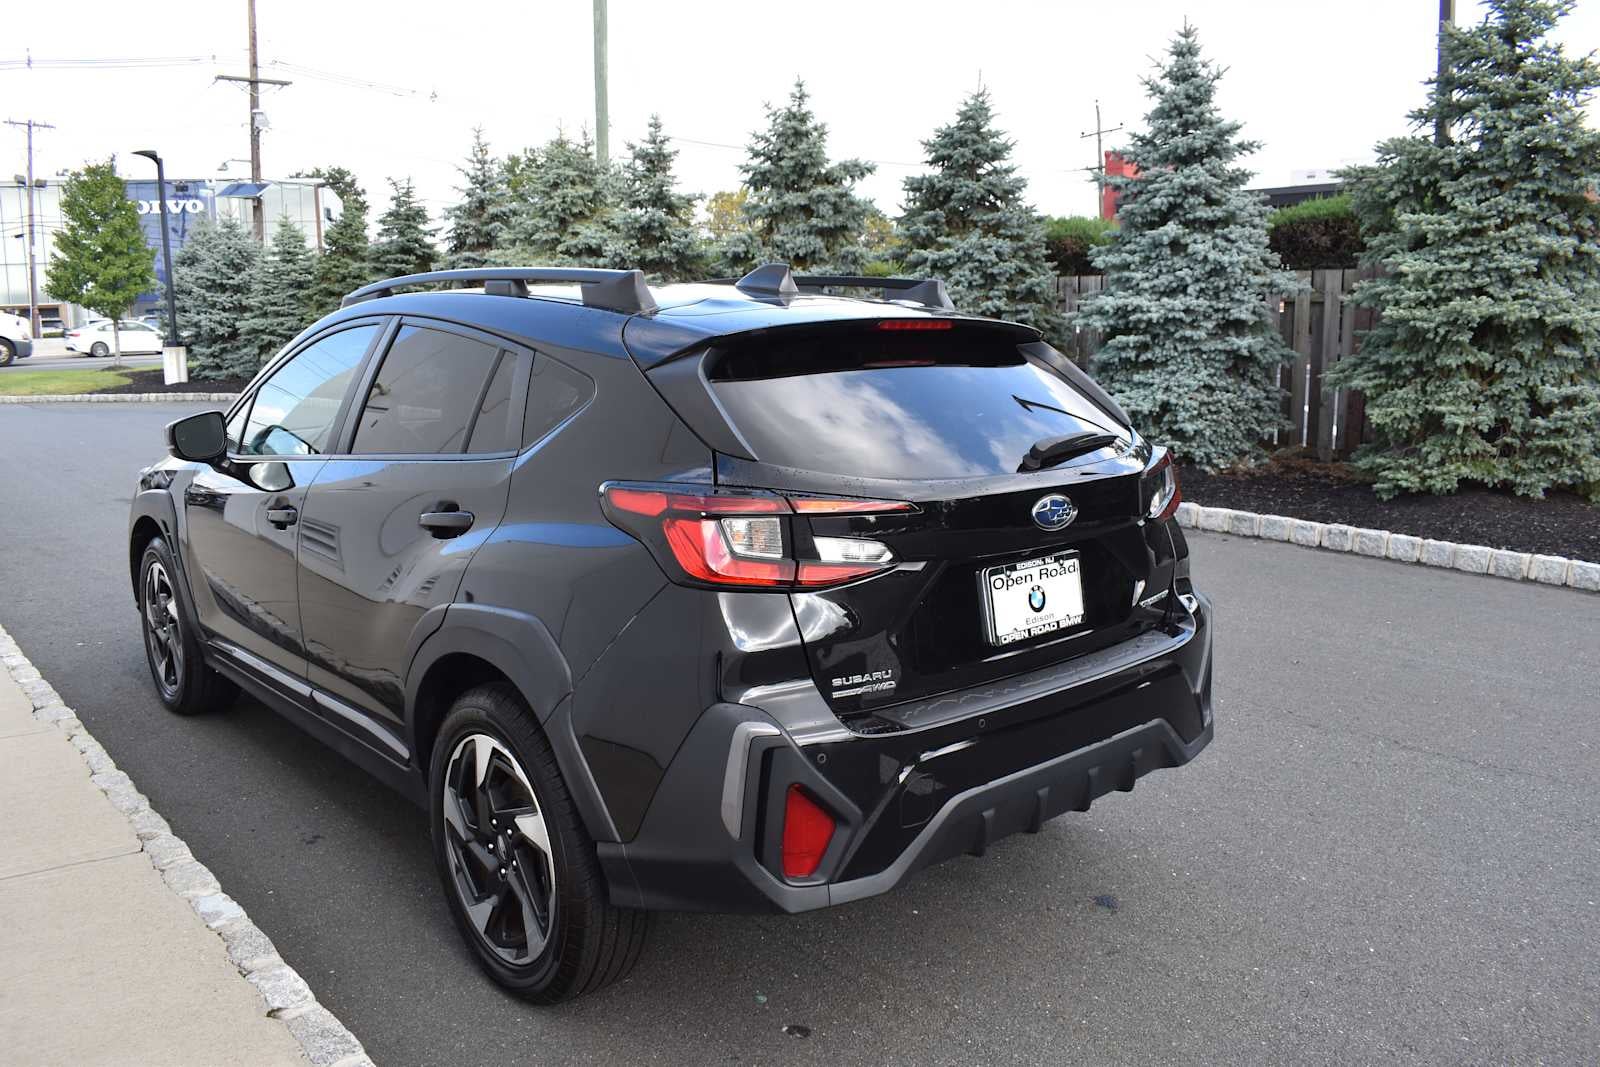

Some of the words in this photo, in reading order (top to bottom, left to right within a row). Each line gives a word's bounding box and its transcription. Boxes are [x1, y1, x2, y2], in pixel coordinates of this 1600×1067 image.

[134, 199, 204, 214] OLVO
[1045, 556, 1055, 565] NJ
[993, 573, 1033, 591] Open
[1040, 561, 1076, 580] Road
[1025, 613, 1055, 626] Edison
[1001, 630, 1029, 645] OPEN
[1030, 621, 1058, 637] ROAD
[1059, 615, 1082, 629] BMW
[831, 669, 892, 687] SUBARU
